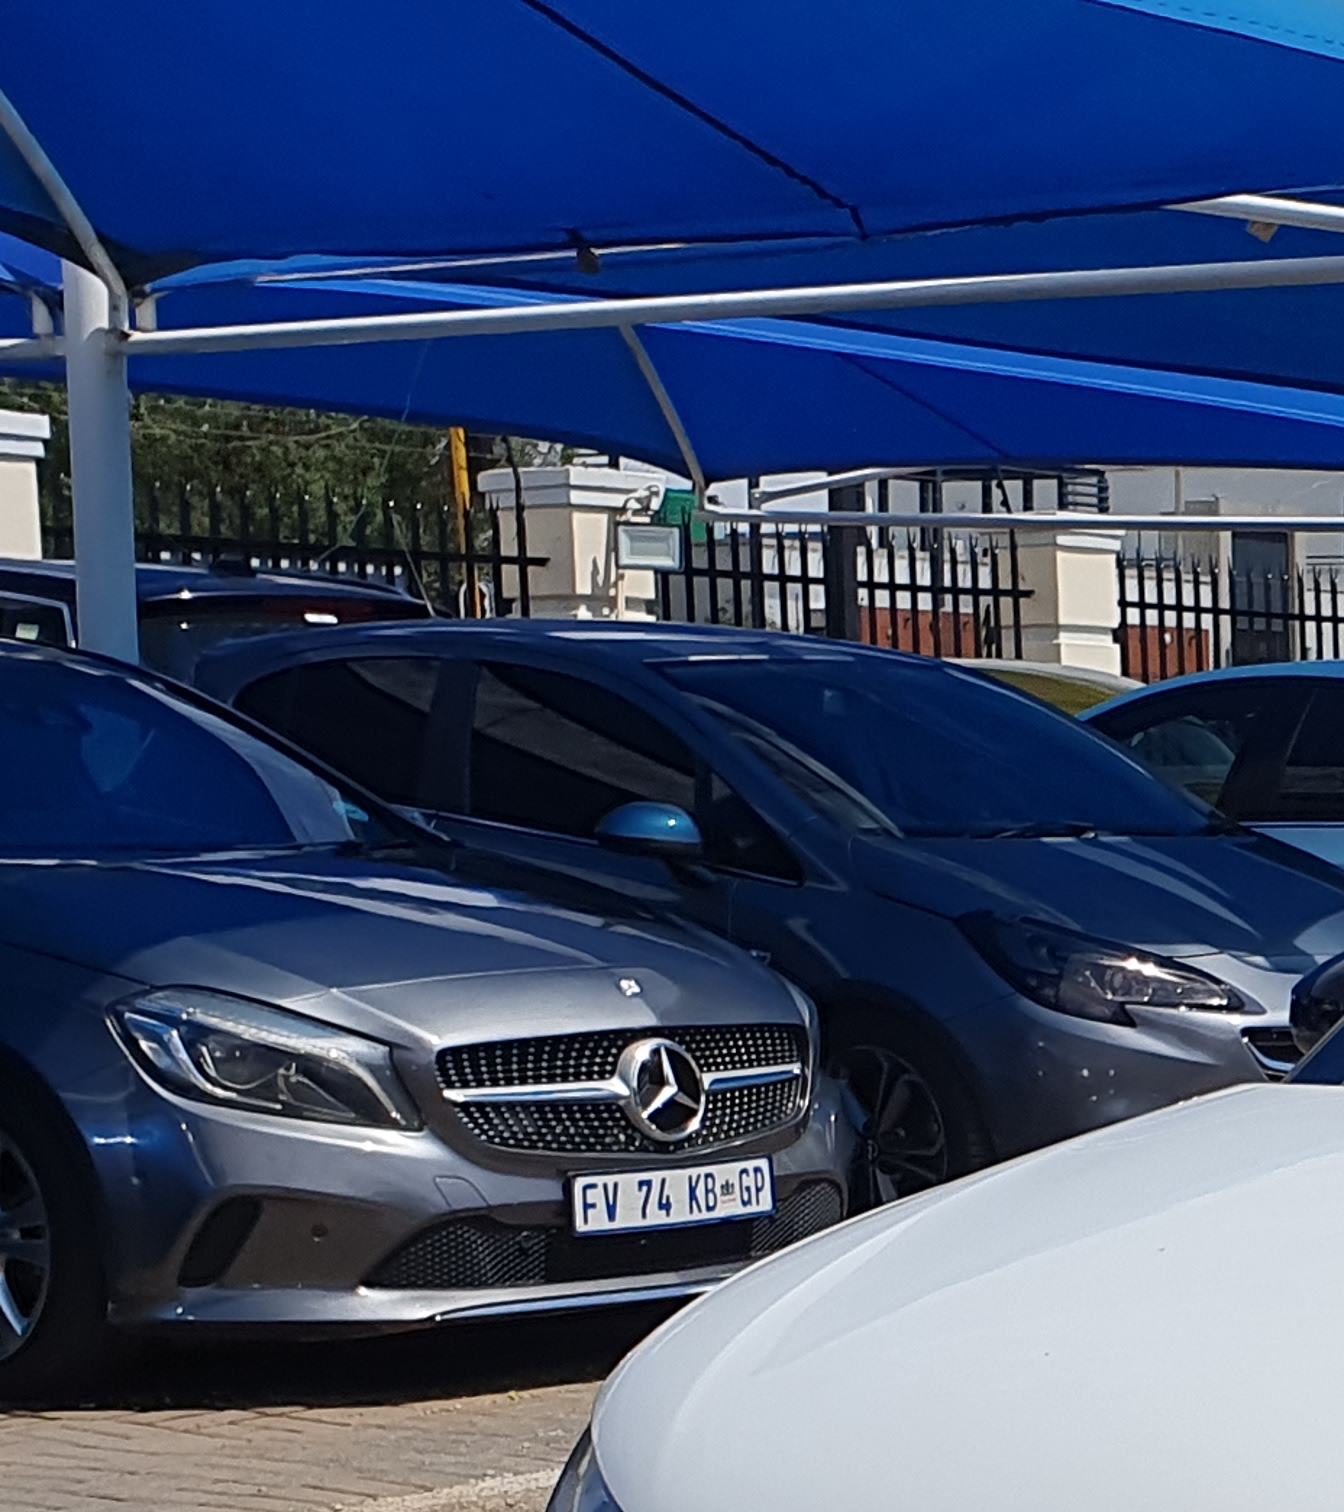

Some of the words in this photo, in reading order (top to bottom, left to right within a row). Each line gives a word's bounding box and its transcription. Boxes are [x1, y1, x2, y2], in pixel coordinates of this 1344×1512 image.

[582, 1181, 619, 1225] FV
[637, 1177, 673, 1220] 74
[688, 1172, 718, 1215] KB
[738, 1166, 766, 1208] GP
